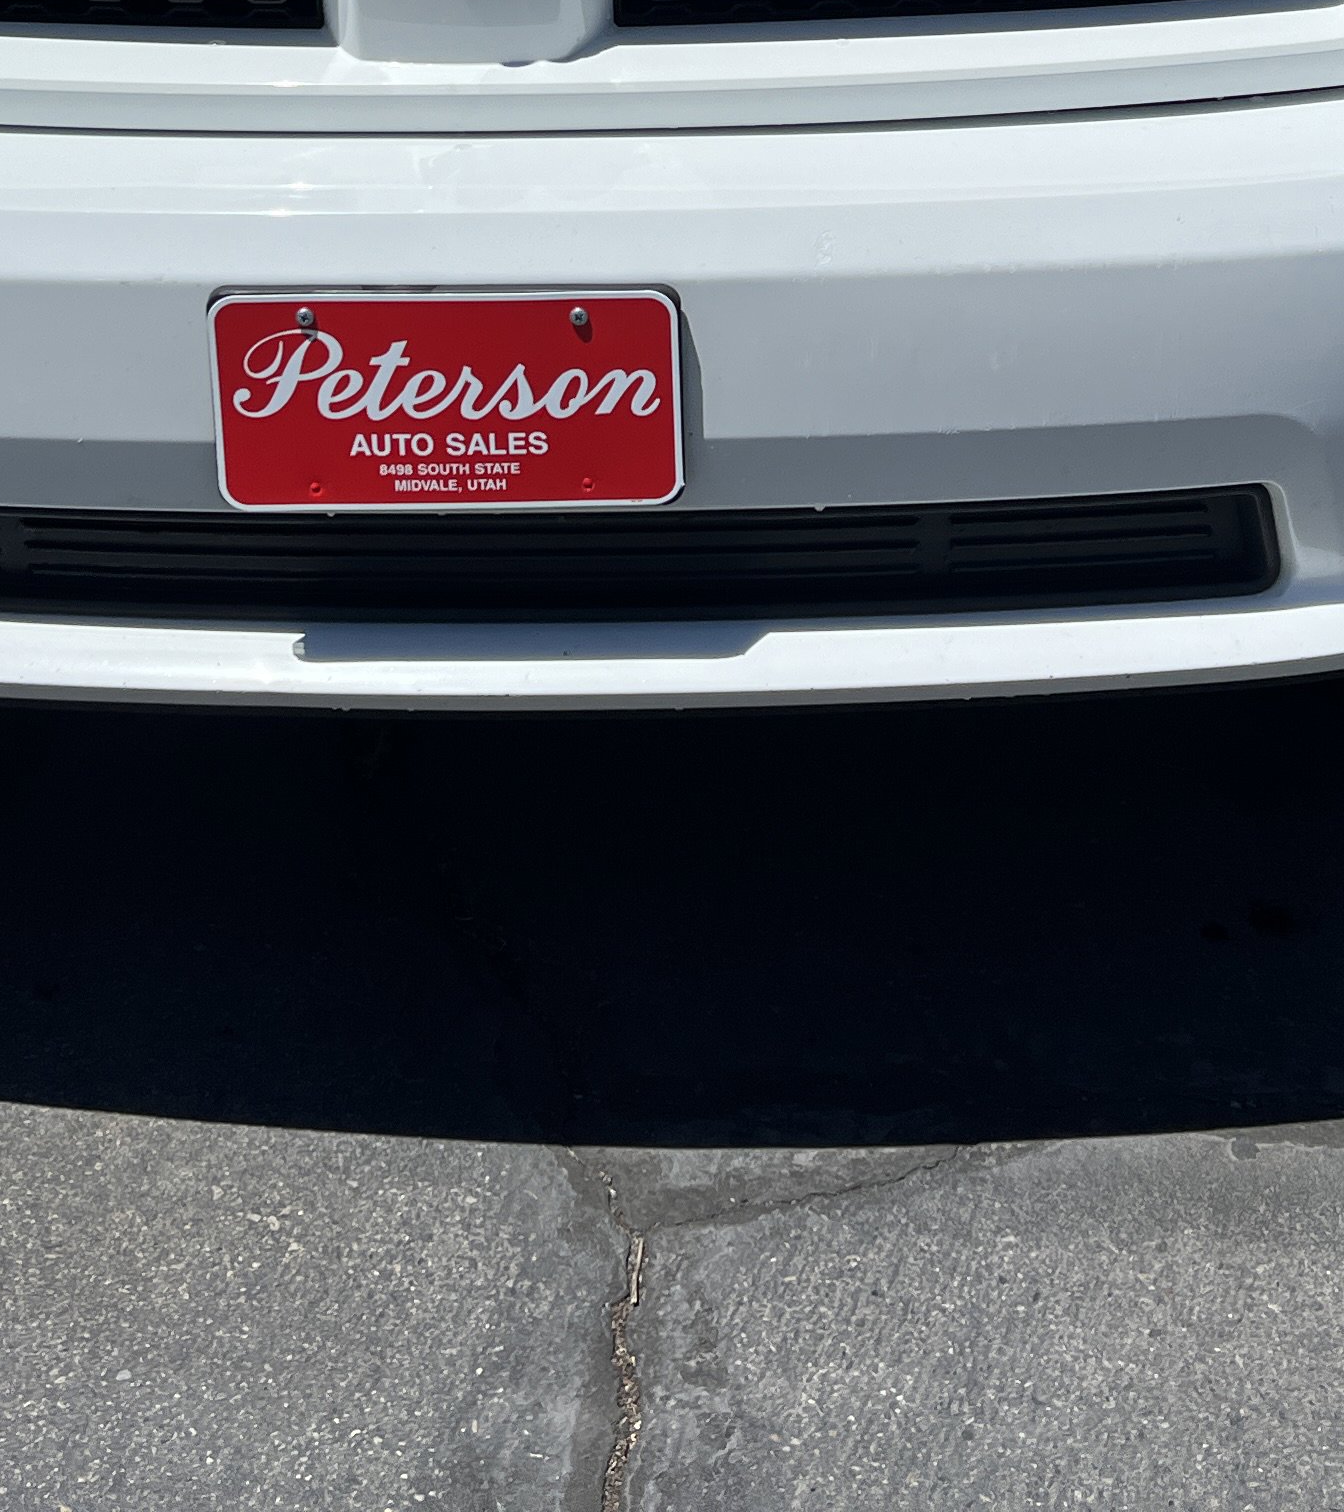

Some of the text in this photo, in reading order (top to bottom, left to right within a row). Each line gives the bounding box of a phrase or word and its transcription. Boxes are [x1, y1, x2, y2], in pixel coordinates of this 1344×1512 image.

[233, 328, 661, 421] Peterson
[350, 431, 549, 456] AUTO SALES
[379, 462, 520, 476] 8498 SOUTH STATE
[395, 478, 507, 493] MIDVALE, UTAH
